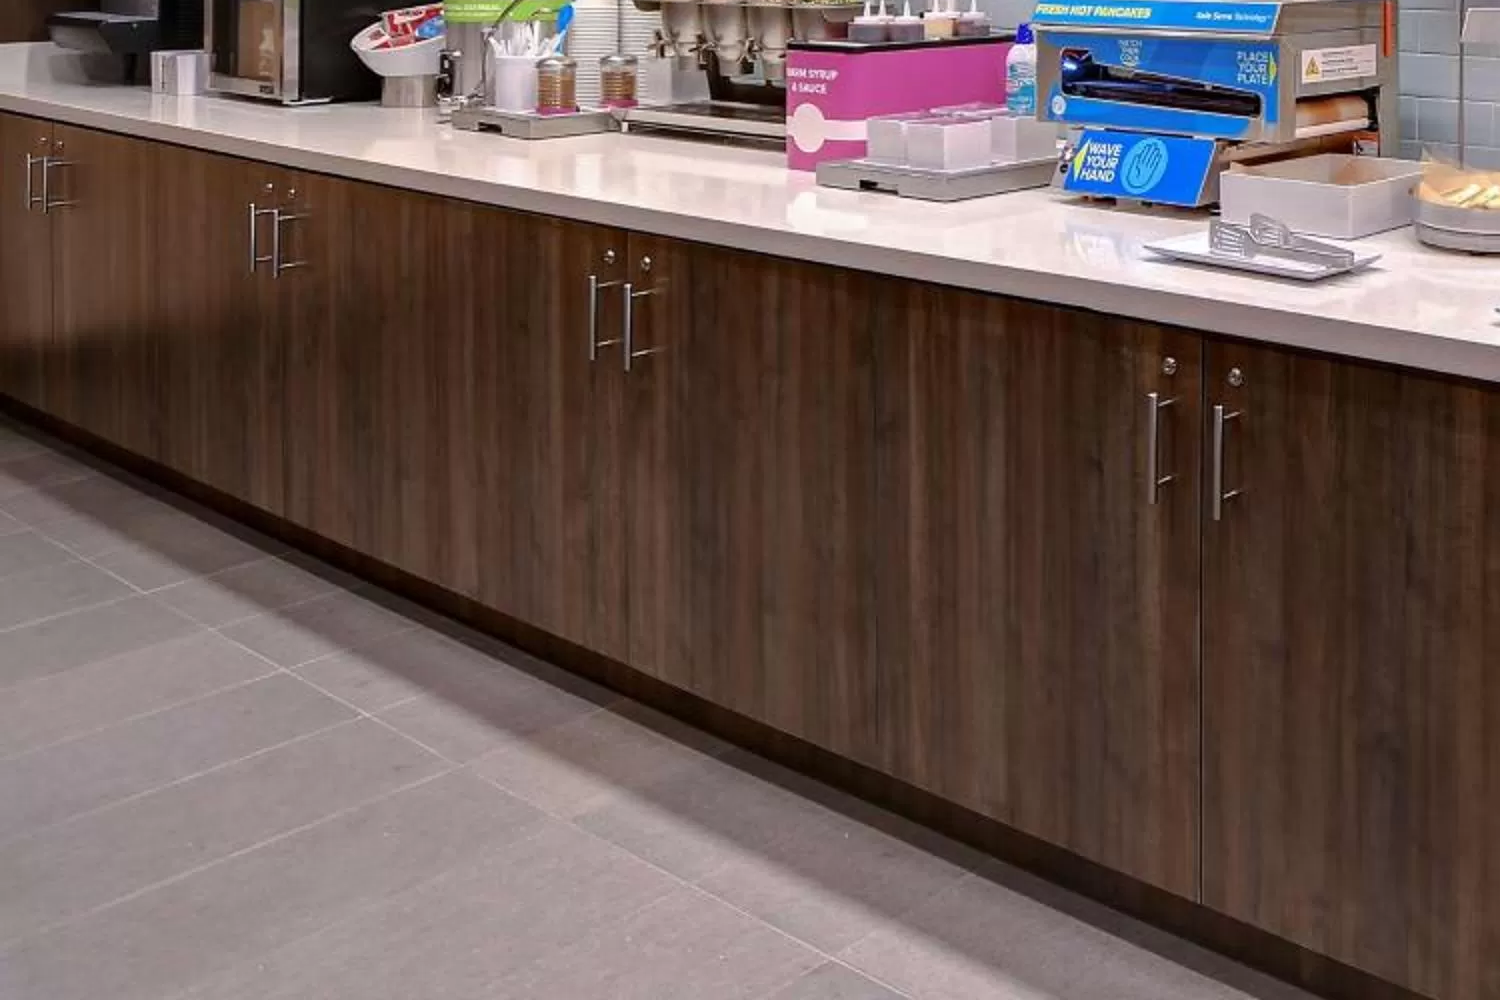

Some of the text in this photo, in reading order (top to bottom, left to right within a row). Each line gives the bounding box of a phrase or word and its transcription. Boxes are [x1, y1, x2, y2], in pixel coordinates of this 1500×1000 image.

[1069, 5, 1094, 17] HOT
[1093, 5, 1152, 19] PANCAKES
[1236, 51, 1269, 62] PLACE
[1238, 62, 1267, 73] YOUR
[1236, 73, 1269, 85] PLATE
[1088, 141, 1122, 157] WAVE
[1085, 156, 1119, 170] YOUR
[1080, 169, 1115, 183] HAND
